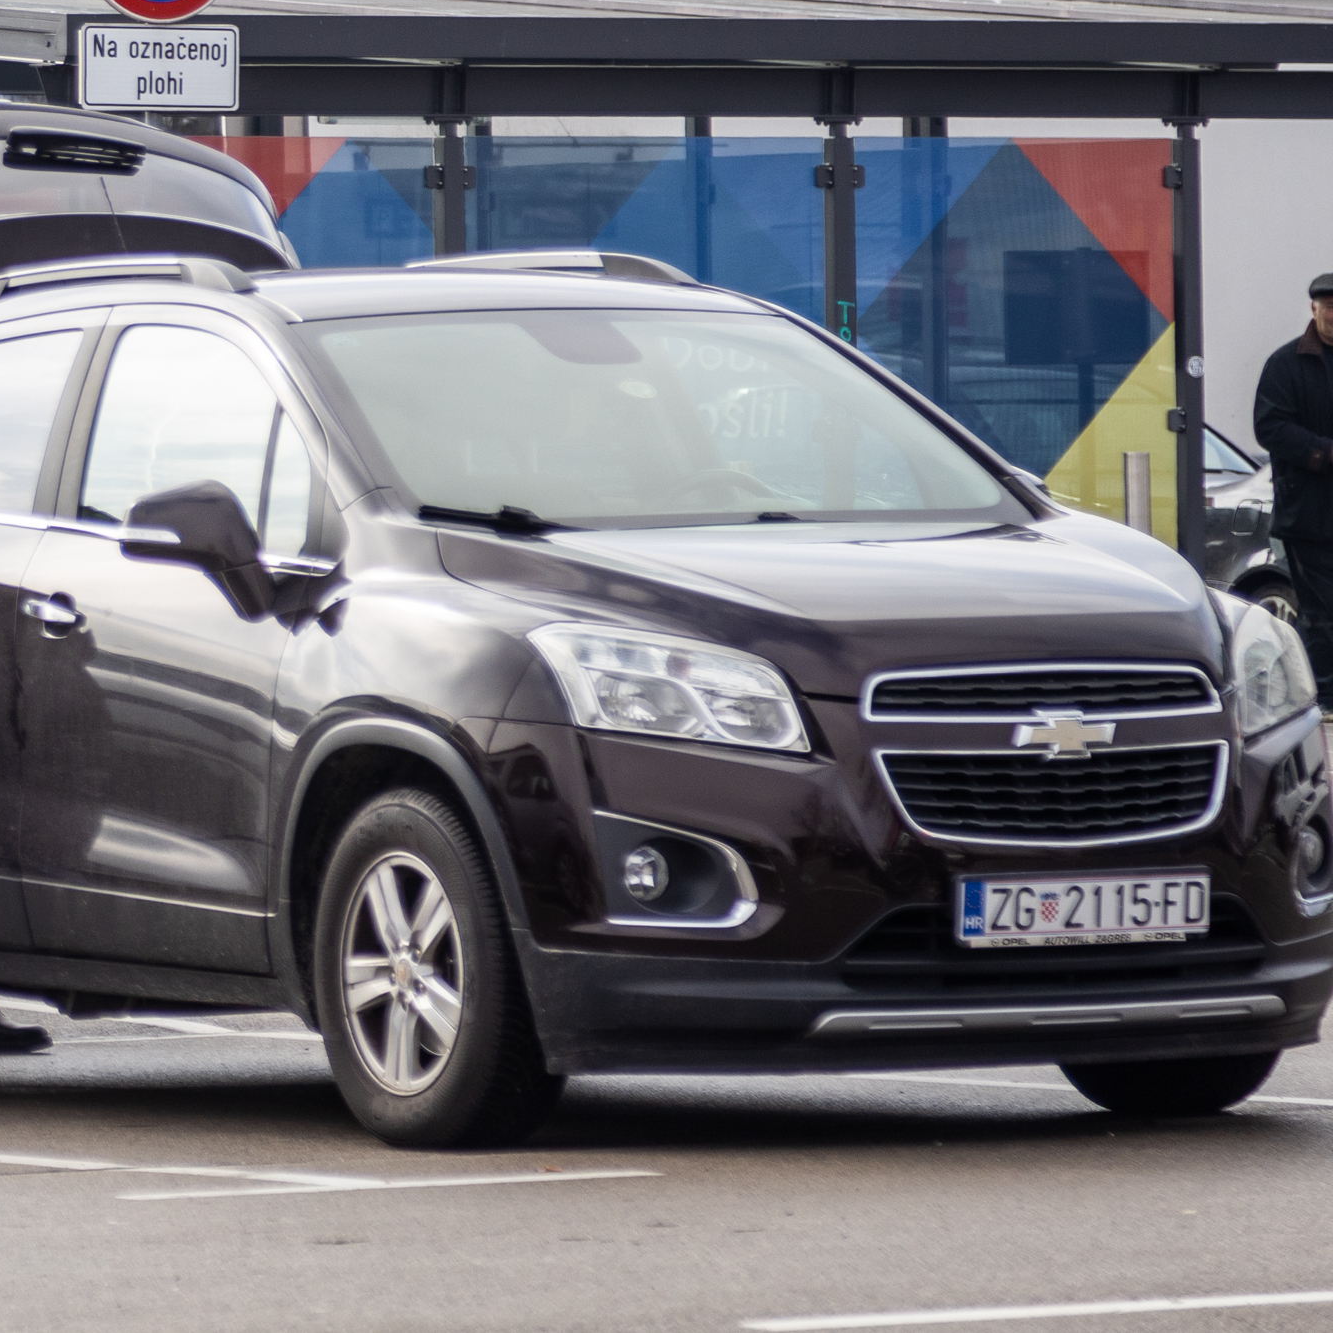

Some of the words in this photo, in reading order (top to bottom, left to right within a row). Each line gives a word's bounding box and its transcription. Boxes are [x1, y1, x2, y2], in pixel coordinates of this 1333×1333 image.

[93, 33, 118, 58] Na
[129, 36, 228, 67] označenoj
[137, 70, 183, 101] plohi
[965, 917, 983, 930] HR
[990, 886, 1037, 931] ZG
[1002, 938, 1031, 946] OPEL
[1154, 931, 1185, 941] OPEL
